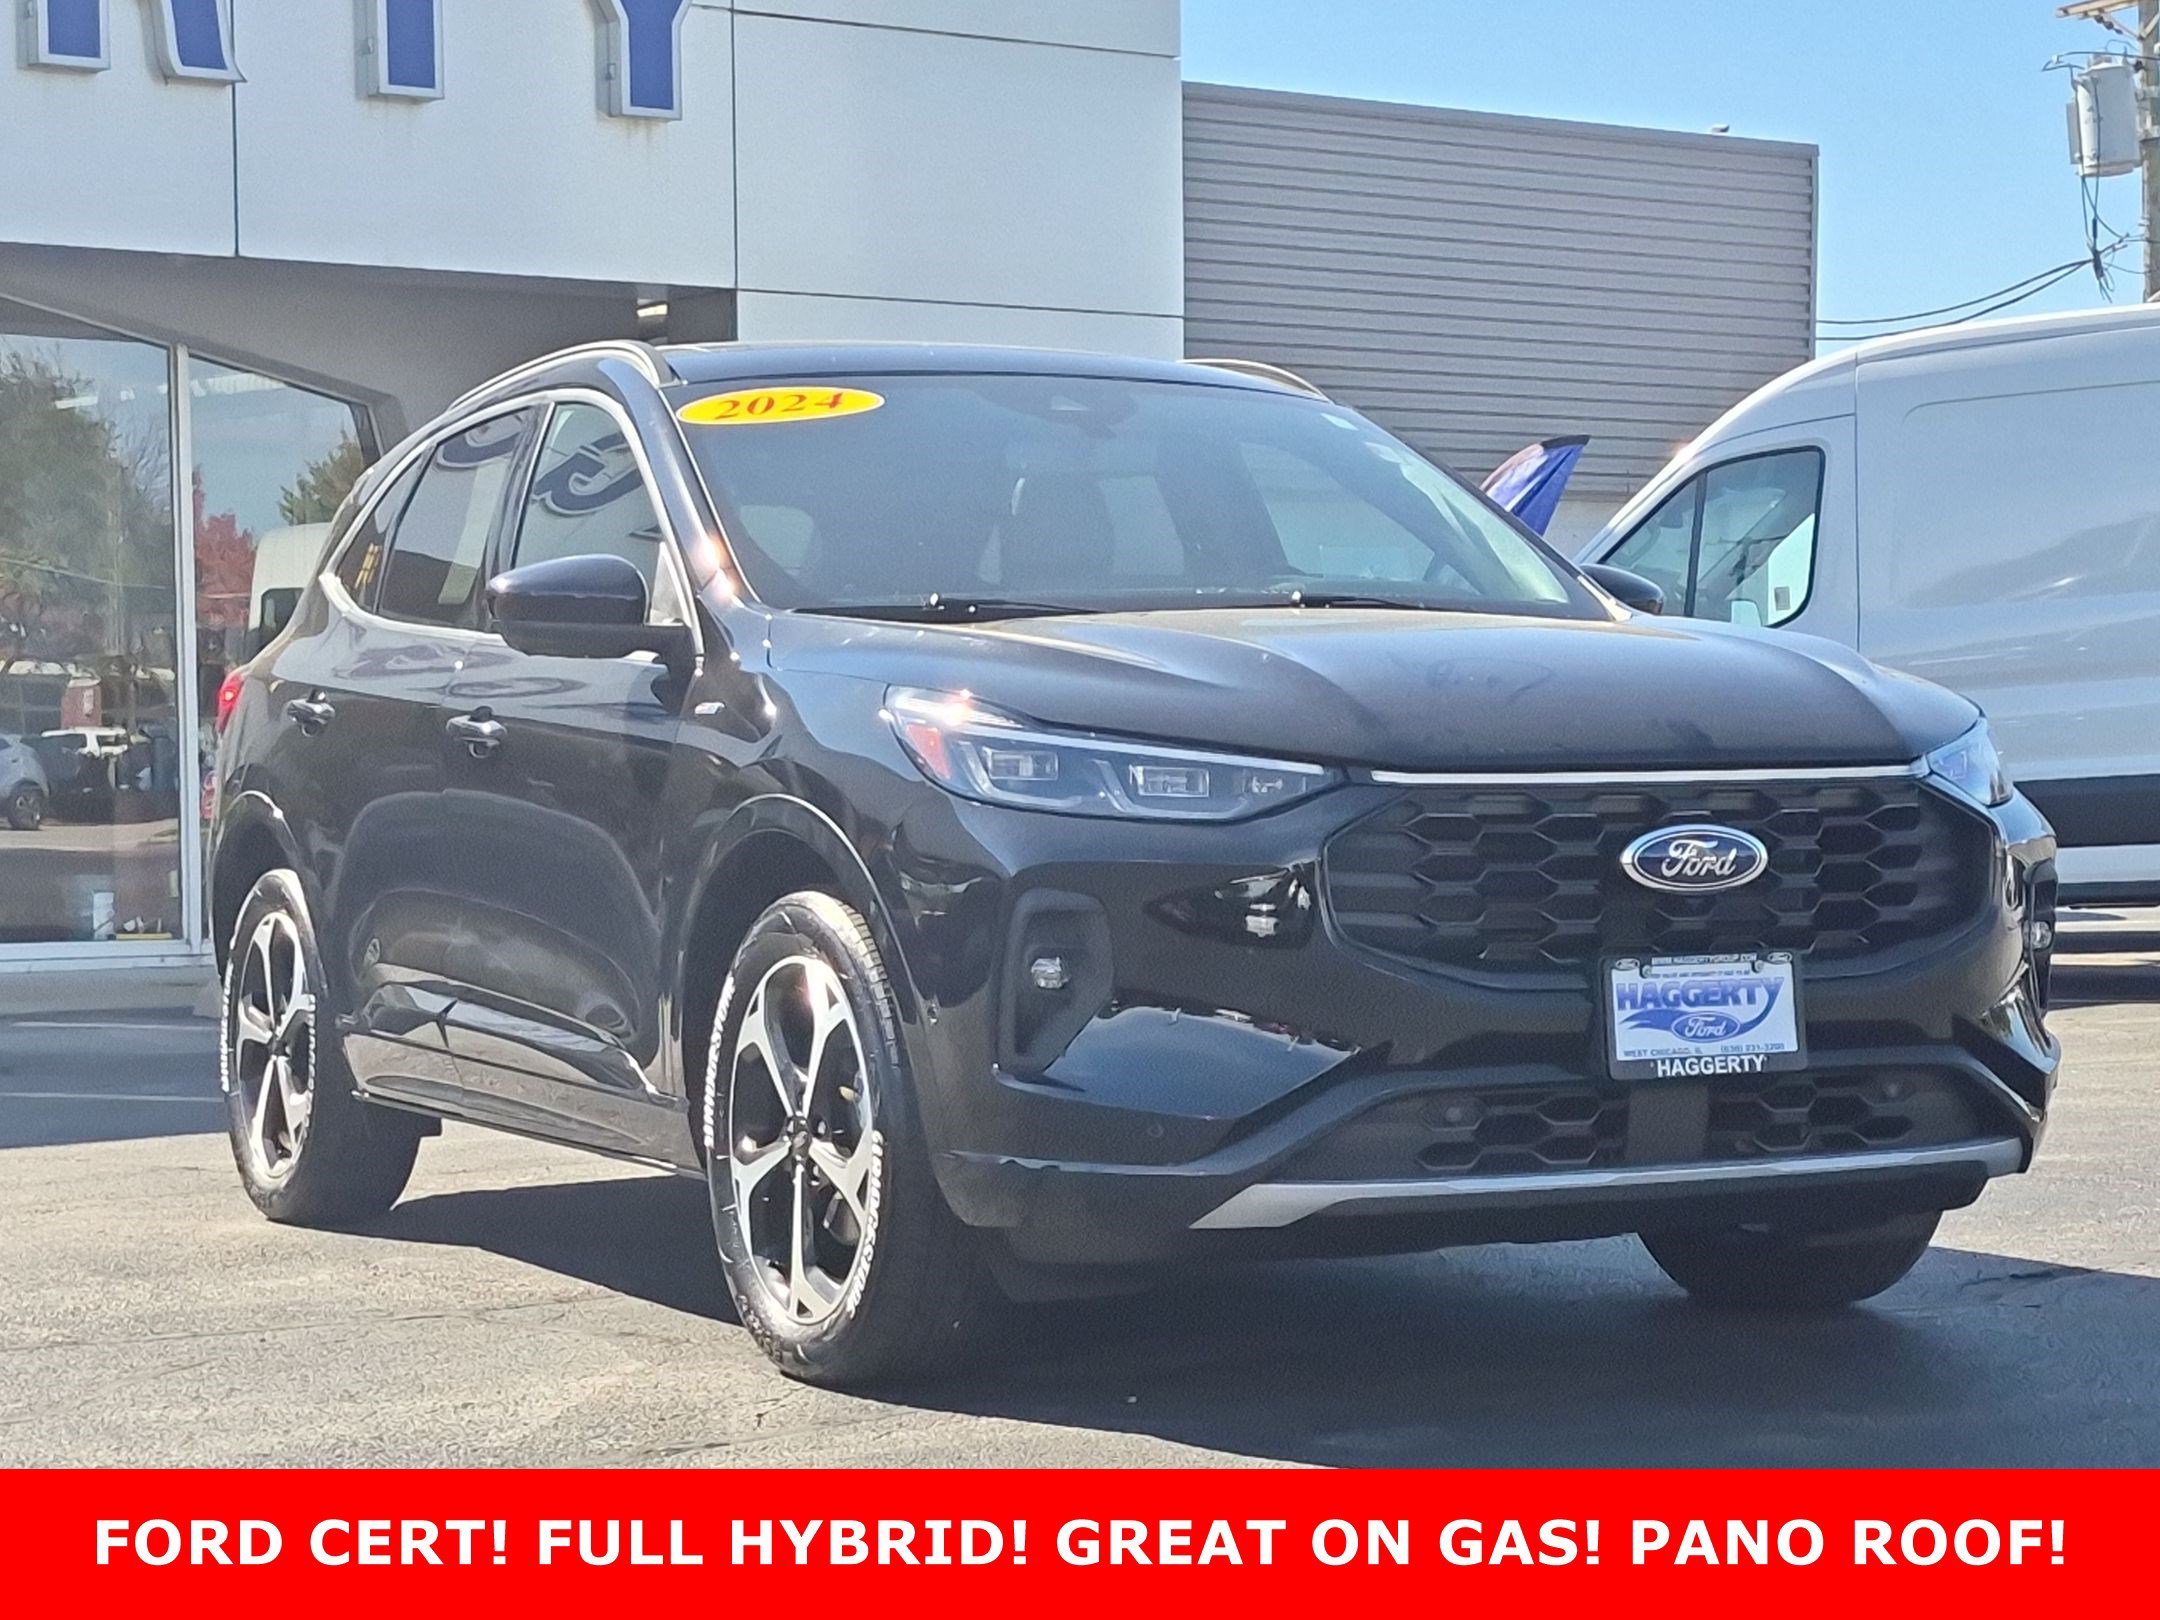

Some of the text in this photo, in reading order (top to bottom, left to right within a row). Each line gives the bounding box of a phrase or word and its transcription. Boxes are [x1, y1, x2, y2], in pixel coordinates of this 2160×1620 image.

[714, 392, 843, 420] 2024
[1661, 839, 1738, 878] Ford
[1616, 976, 1785, 1011] HAGGERTY
[1684, 1015, 1727, 1038] Ford
[1657, 1054, 1765, 1078] HAGGERTY
